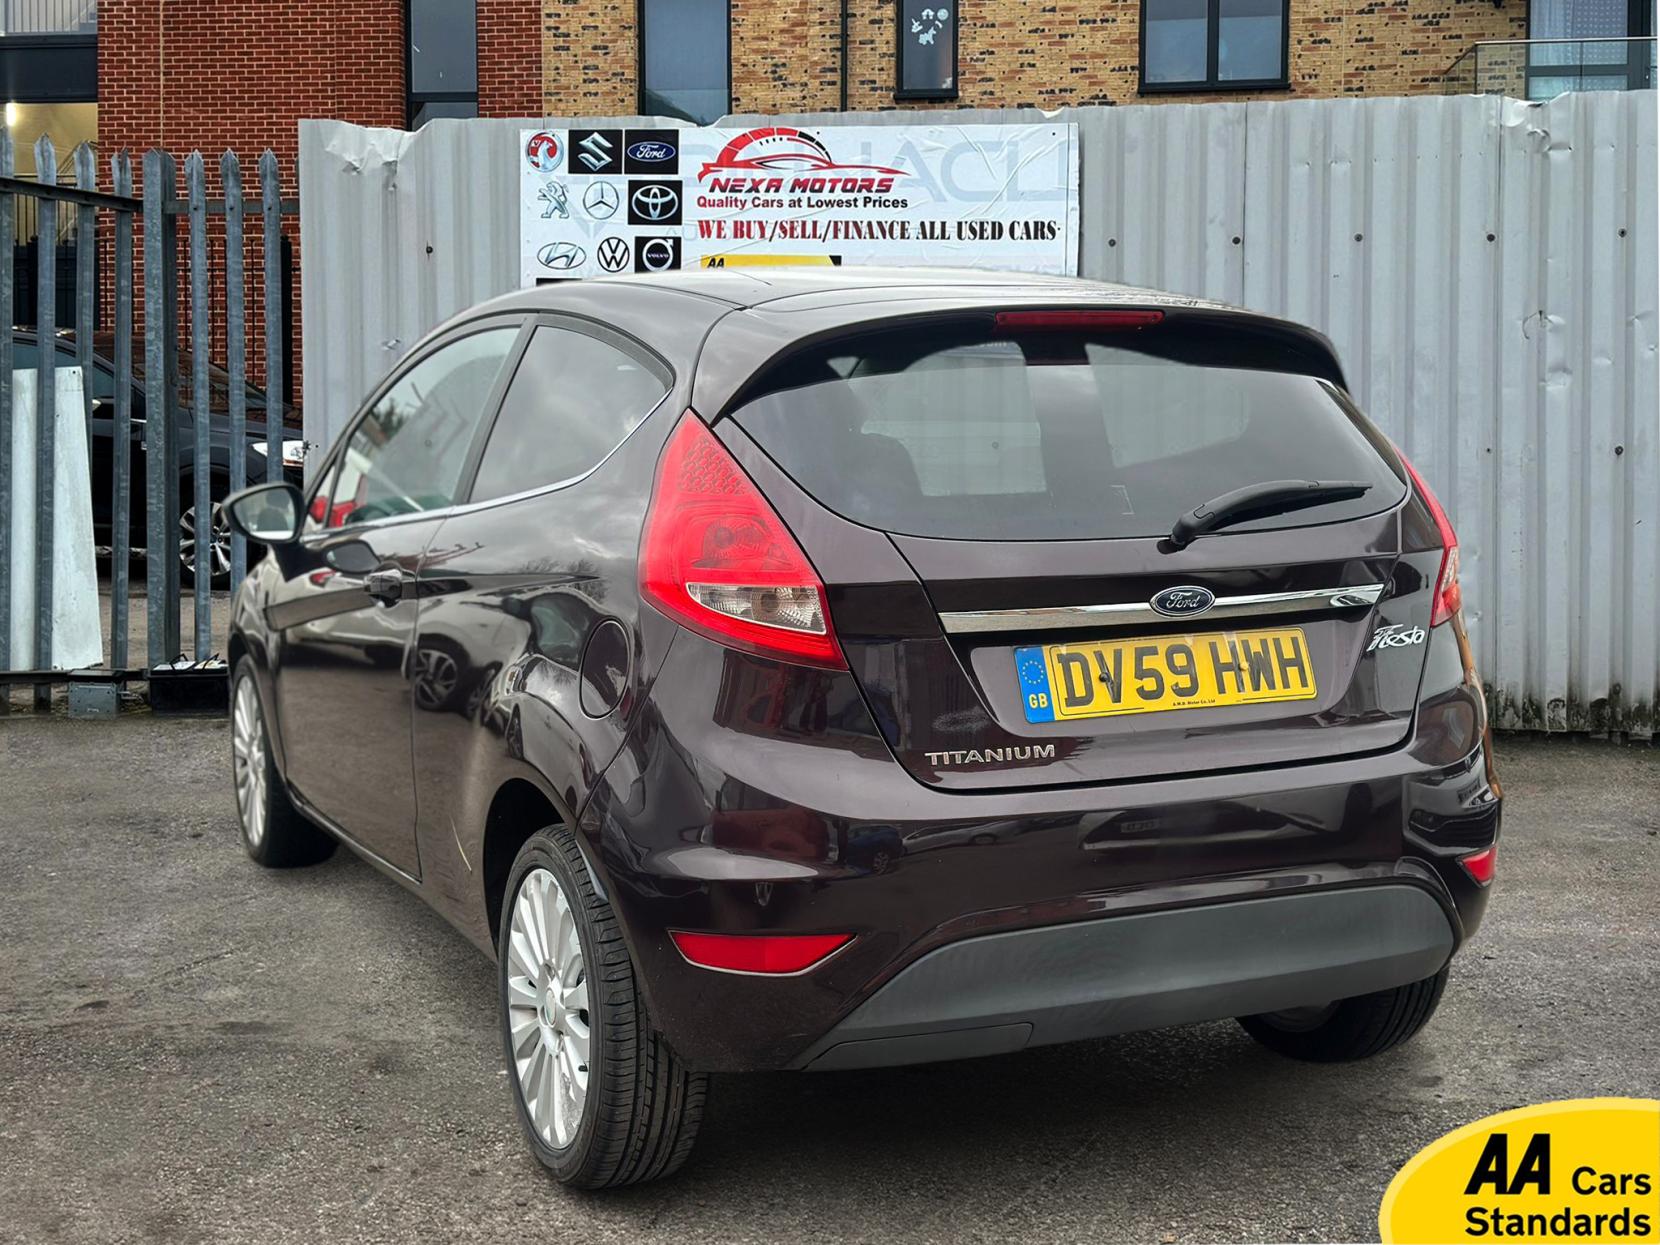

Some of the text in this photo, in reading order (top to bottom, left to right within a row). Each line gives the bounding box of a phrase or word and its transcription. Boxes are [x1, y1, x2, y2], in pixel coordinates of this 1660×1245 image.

[637, 144, 665, 158] Ford
[709, 178, 894, 193] NEXA MOTORS
[697, 196, 908, 210] Quality Cars at Lowest Prices
[697, 220, 726, 239] WE
[733, 220, 910, 242] BUY/SELL/FINANCE
[916, 221, 951, 240] ALL
[957, 221, 1003, 240] USED
[1009, 221, 1057, 240] CARS
[706, 258, 725, 268] AA
[1166, 592, 1200, 608] Ford
[1366, 624, 1425, 652] Fiesta
[1057, 636, 1309, 708] DV59 HWH
[1028, 692, 1049, 709] GB
[924, 744, 1056, 765] TITANIUM
